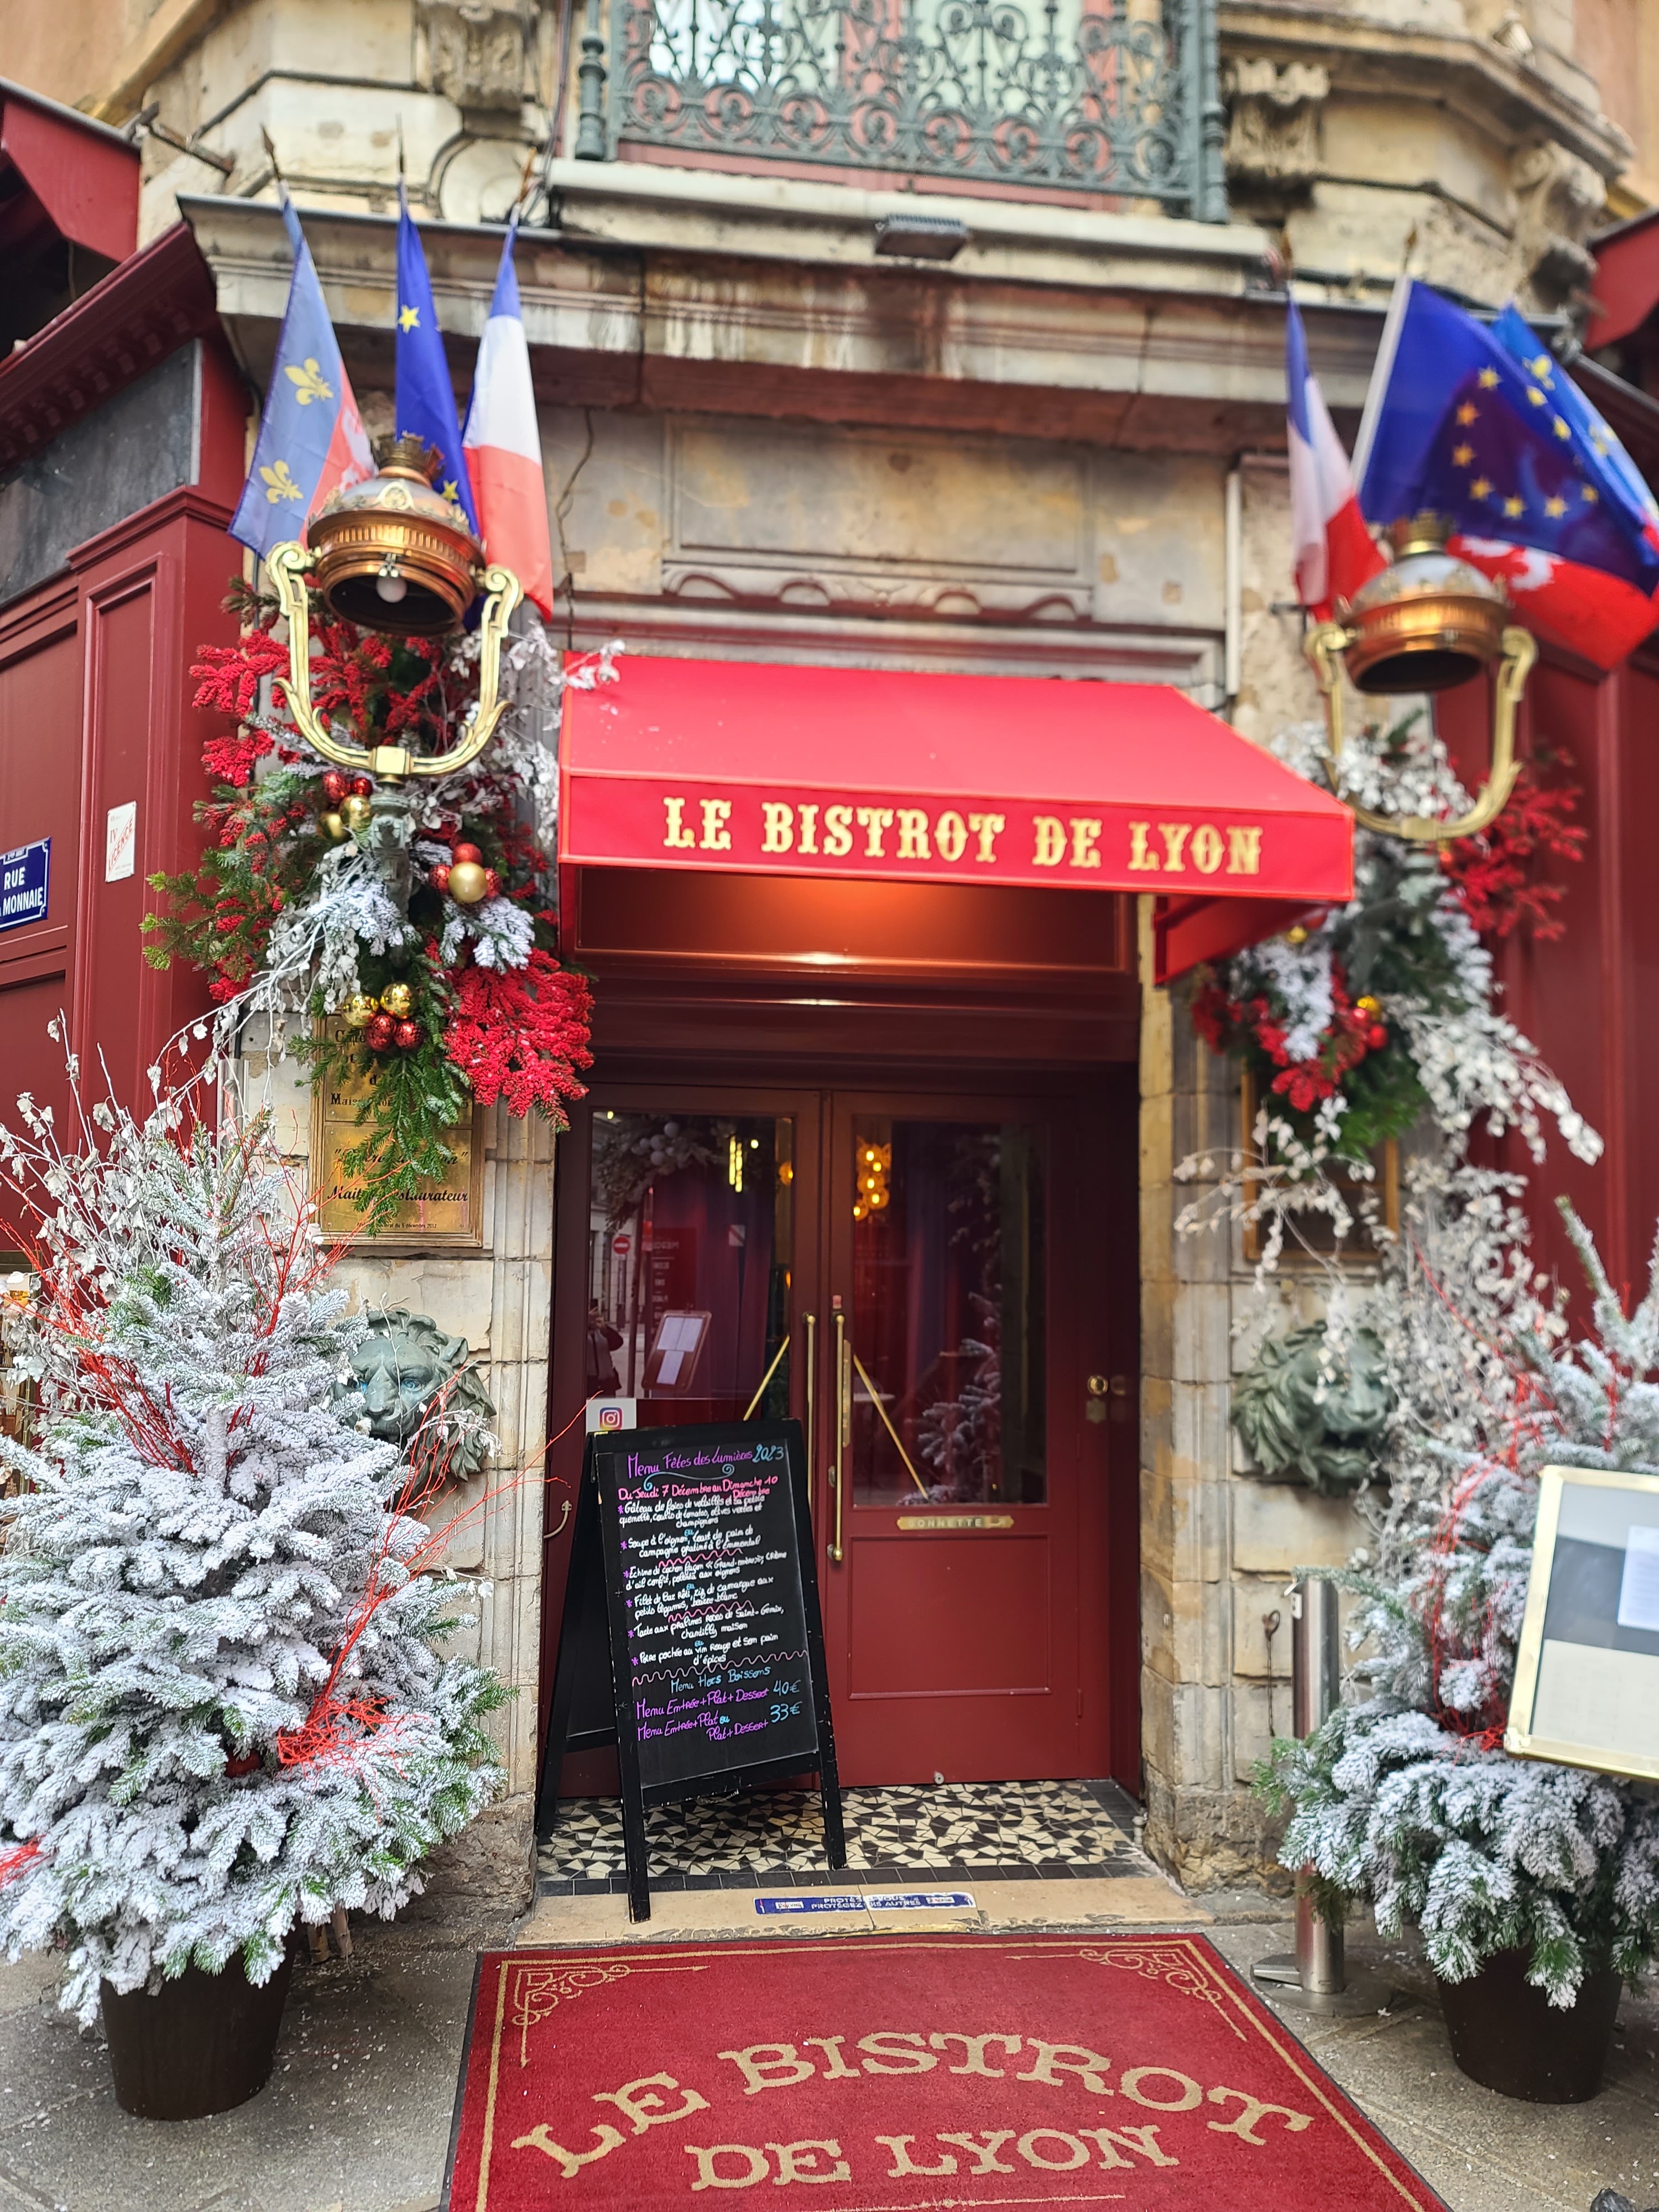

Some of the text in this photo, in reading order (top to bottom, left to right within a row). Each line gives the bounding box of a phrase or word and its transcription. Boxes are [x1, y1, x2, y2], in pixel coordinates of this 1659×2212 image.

[108, 818, 133, 872] LICENCE
[110, 828, 118, 844] IV
[663, 796, 1263, 875] LE BISTROT DE LYON
[4, 867, 25, 890] RUE
[3, 886, 43, 916] MONNAIE
[393, 1190, 468, 1202] estaurateur
[628, 1444, 784, 1479] Menu Fêtes des Lumières 2023
[618, 1488, 633, 1500] Du
[632, 1486, 659, 1499] Jeudi
[662, 1484, 669, 1497] 7
[671, 1482, 711, 1496] Décembre
[722, 1477, 762, 1491] Dimanche
[764, 1475, 778, 1485] 10
[733, 1486, 770, 1498] Décembre
[624, 1500, 653, 1514] Gâteau
[655, 1500, 665, 1512] de
[666, 1498, 684, 1514] foies
[684, 1498, 692, 1509] de
[693, 1494, 724, 1507] volailles
[725, 1495, 732, 1506] et
[743, 1494, 765, 1507] petite
[653, 1510, 675, 1521] coulis
[675, 1510, 682, 1520] de
[683, 1508, 709, 1519] tomates,
[711, 1506, 731, 1516] olives
[732, 1505, 753, 1515] vertes
[754, 1502, 763, 1512] et
[676, 1517, 718, 1528] champignons
[909, 1518, 982, 1528] SONNETTE
[628, 1537, 649, 1550] Soupe
[650, 1535, 656, 1545] à
[712, 1528, 722, 1540] de
[726, 1528, 744, 1543] pain
[745, 1524, 753, 1535] de
[639, 1547, 679, 1559] campagne
[681, 1541, 708, 1557] gratiné
[708, 1539, 713, 1550] à
[626, 1578, 646, 1590] d'ail
[672, 1572, 696, 1587] polenta
[715, 1567, 740, 1580] oignons
[629, 1566, 652, 1579] Echine
[653, 1566, 660, 1575] de
[662, 1564, 683, 1574] cochon
[685, 1561, 704, 1575] façon
[634, 1594, 652, 1607] Filet
[654, 1593, 661, 1604] de
[662, 1592, 675, 1602] Bar
[693, 1587, 706, 1599] riz
[707, 1583, 714, 1595] de
[757, 1577, 774, 1585] aux
[634, 1607, 655, 1621] petits
[691, 1595, 714, 1607] beurre
[714, 1590, 738, 1602] blanc
[634, 1623, 653, 1637] Tarte
[654, 1625, 669, 1634] aux
[670, 1616, 702, 1635] pralines
[725, 1610, 733, 1619] de
[681, 1622, 748, 1639] chantilly maison
[640, 1652, 656, 1663] Poire
[659, 1647, 682, 1663] pochée
[732, 1636, 742, 1647] et
[743, 1636, 757, 1646] son
[760, 1633, 778, 1645] pain
[693, 1654, 726, 1667] d'épices
[671, 1666, 771, 1693] Menu Hors Boissons
[637, 1698, 665, 1720] Menu
[735, 1688, 769, 1702] Dessert
[773, 1679, 801, 1696] 40€
[638, 1721, 663, 1741] Menu
[719, 1715, 730, 1724] ou
[770, 1701, 802, 1723] 33€
[734, 1719, 769, 1735] Dessert
[510, 2031, 1314, 2179] LE BISTROT
[684, 2125, 1181, 2191] DE LYON
